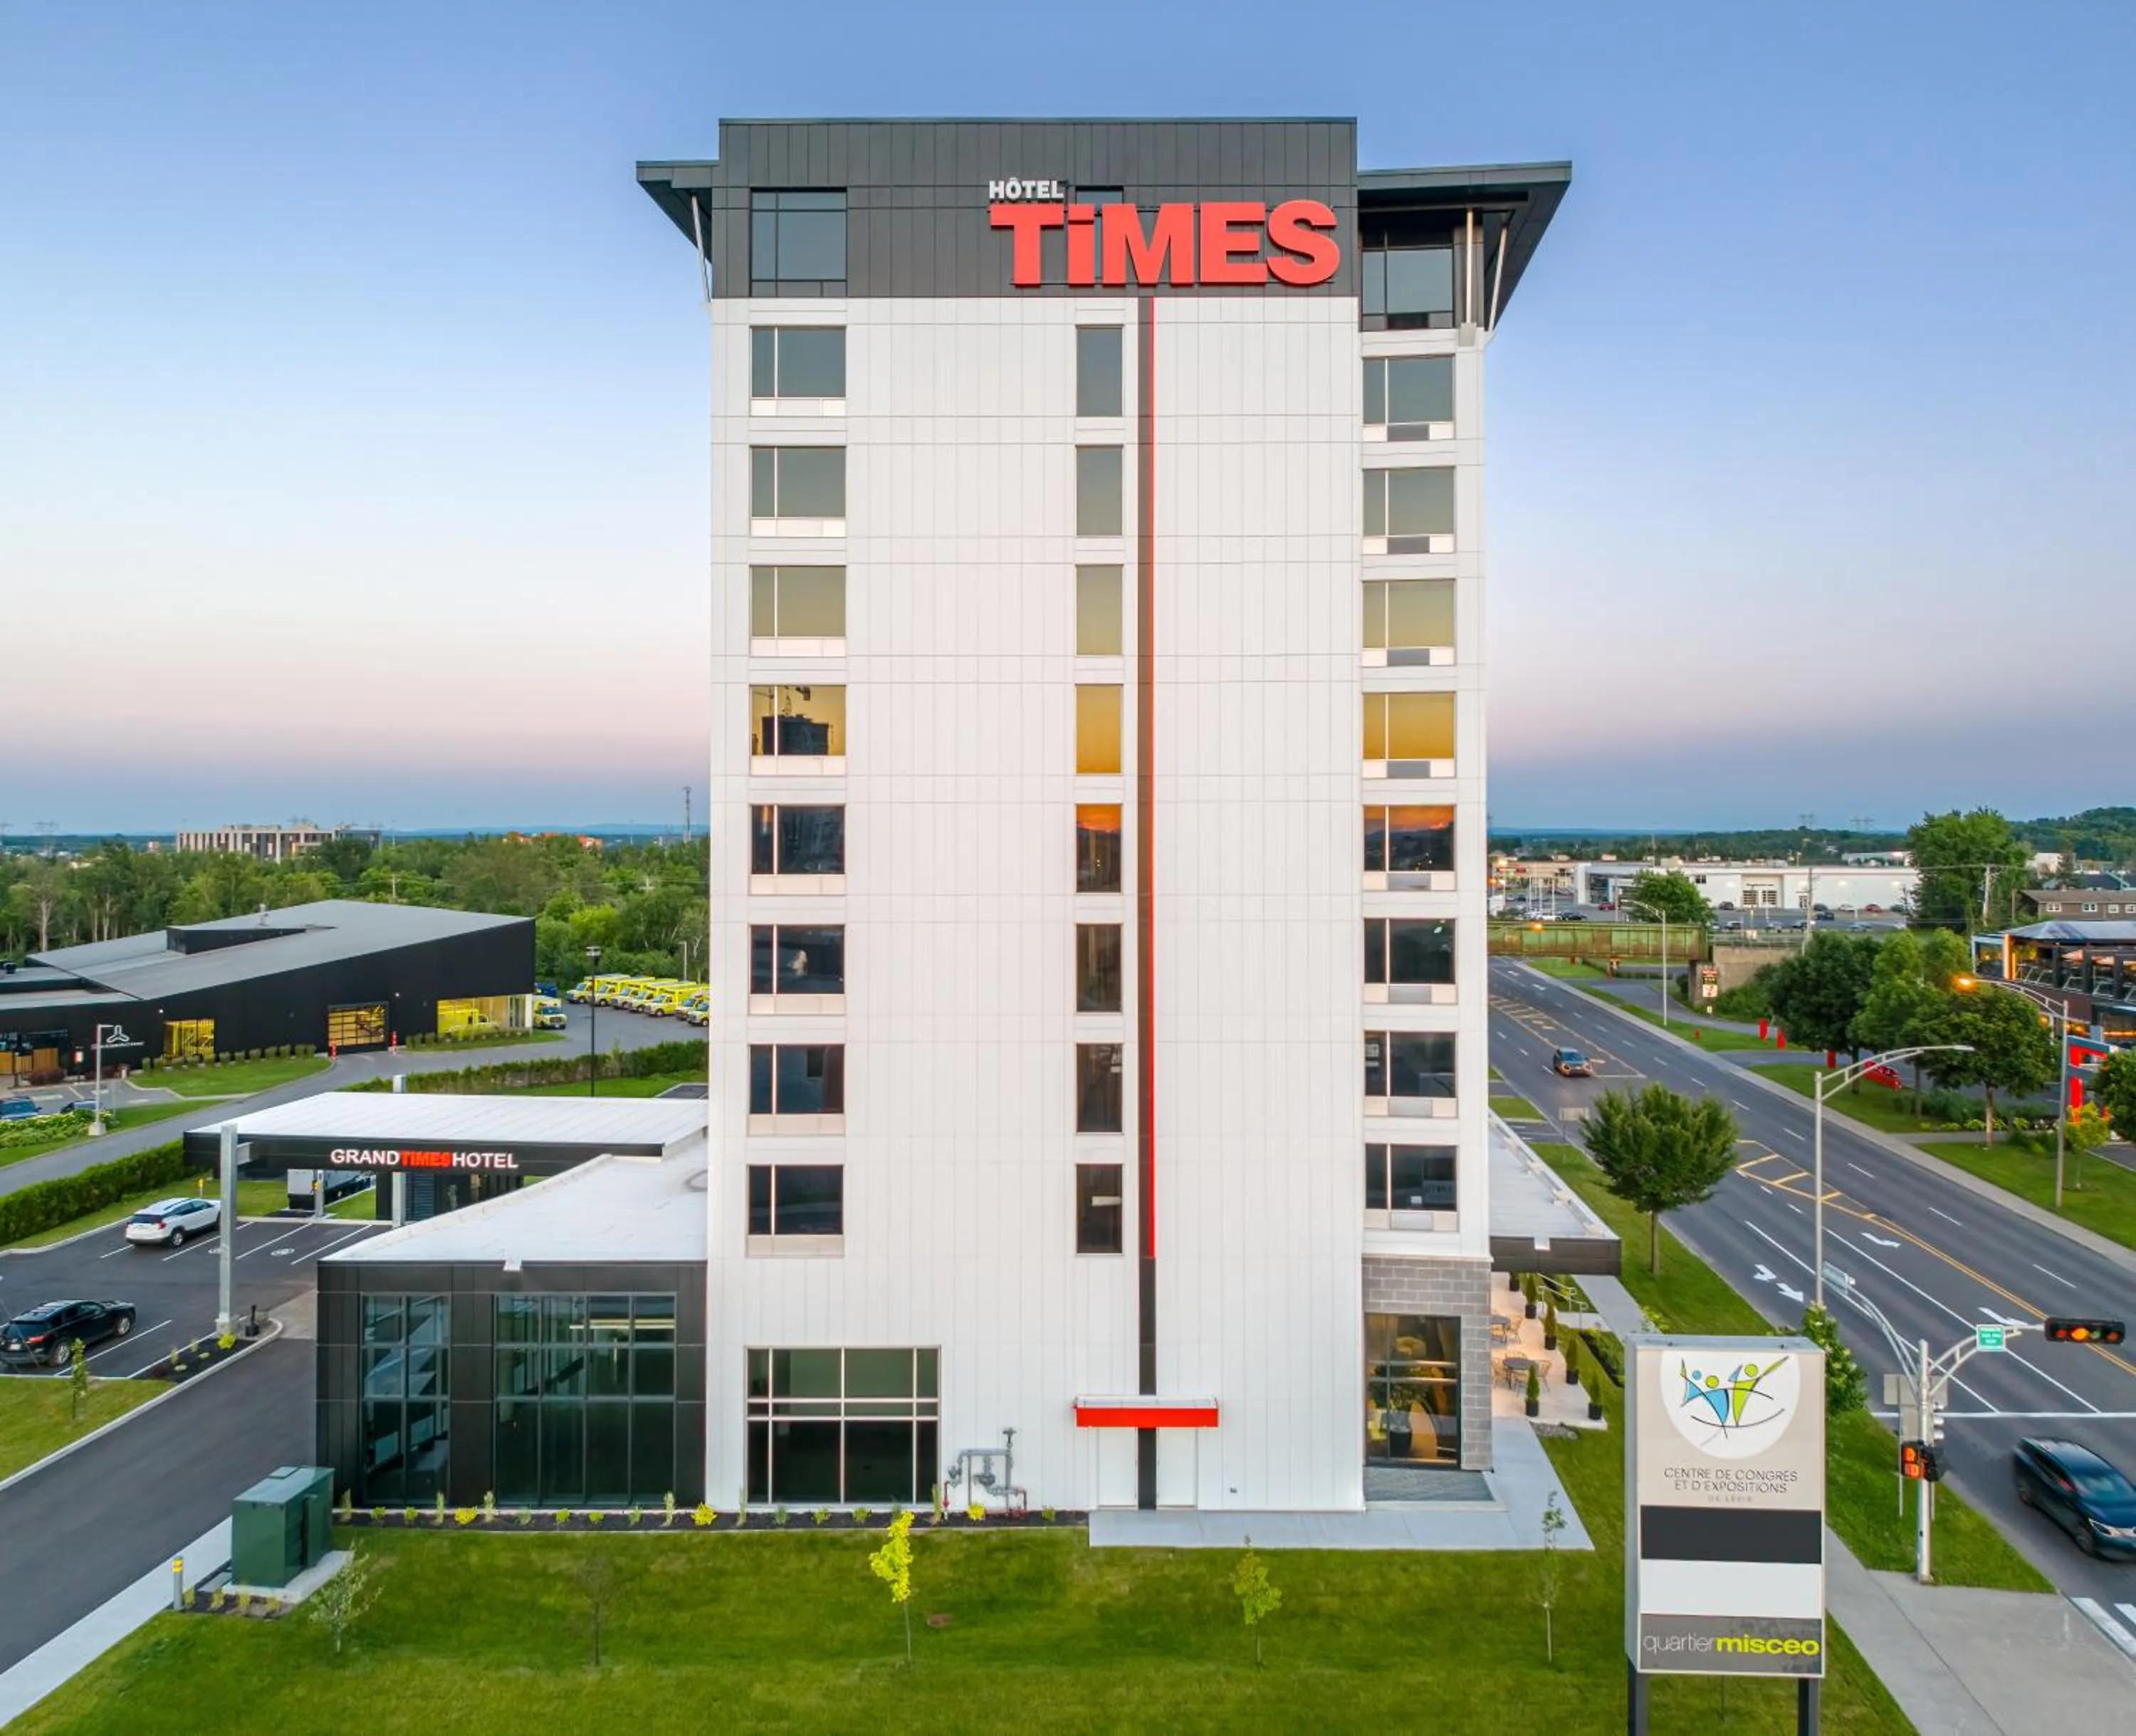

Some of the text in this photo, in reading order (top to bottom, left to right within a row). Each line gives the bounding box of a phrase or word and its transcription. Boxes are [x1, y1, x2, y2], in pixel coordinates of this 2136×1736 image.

[988, 177, 1064, 199] HÔTEL
[1664, 1468, 1712, 1479] CENTRE
[1715, 1469, 1732, 1480] DE
[1675, 1480, 1687, 1490] ET
[1717, 1634, 1820, 1656] misceo
